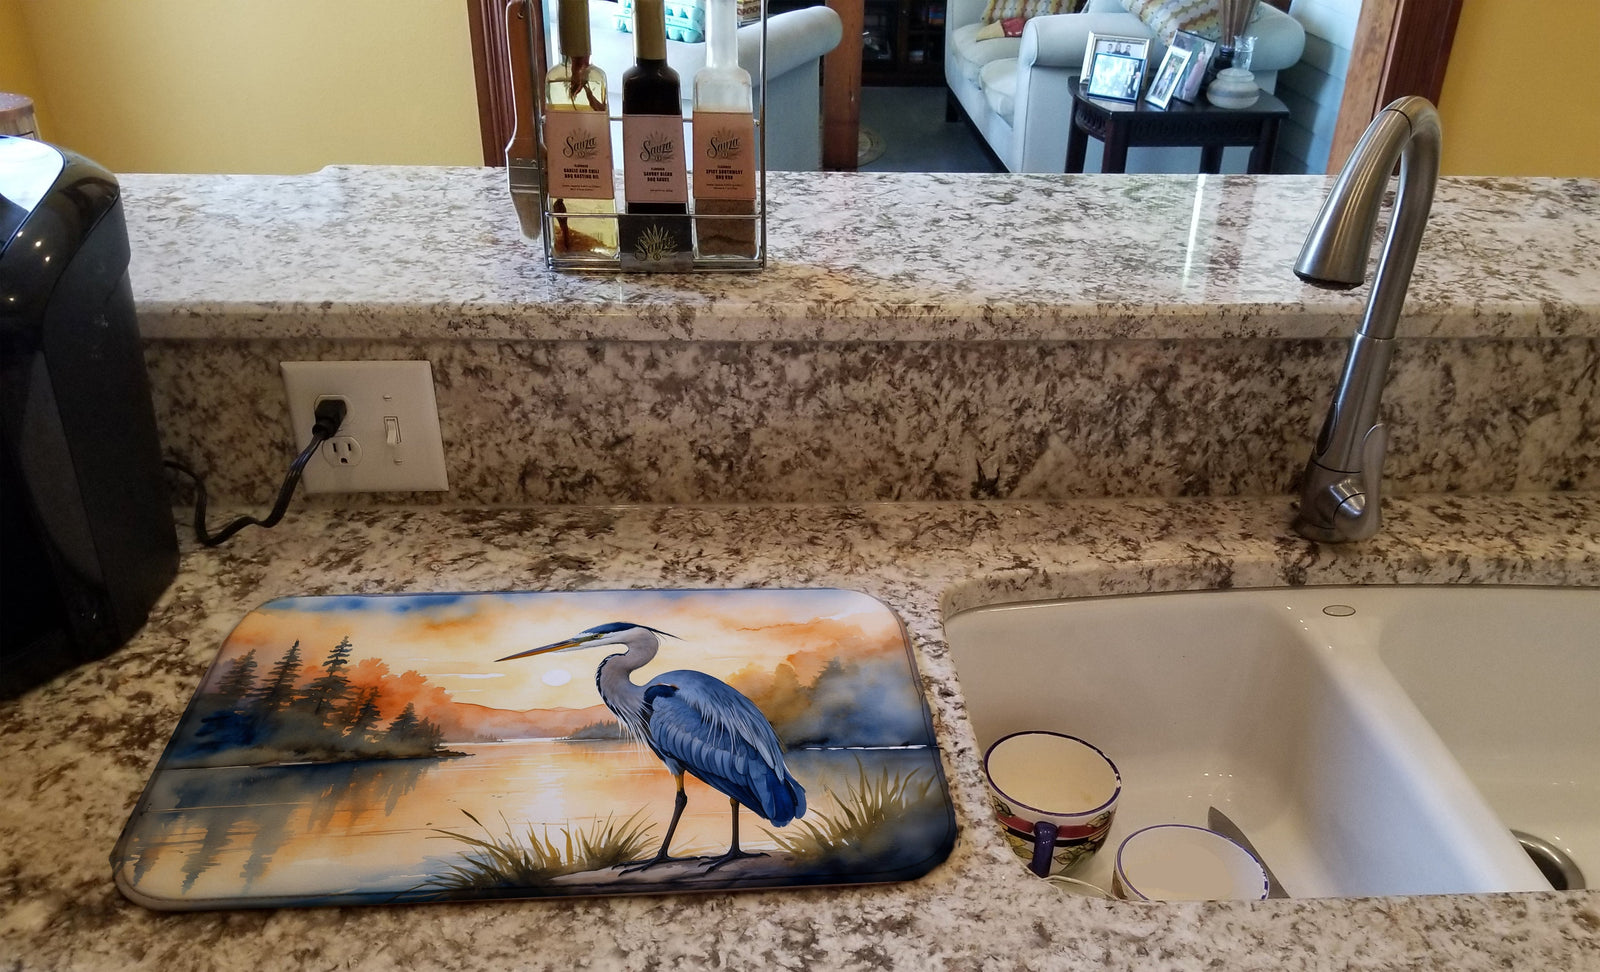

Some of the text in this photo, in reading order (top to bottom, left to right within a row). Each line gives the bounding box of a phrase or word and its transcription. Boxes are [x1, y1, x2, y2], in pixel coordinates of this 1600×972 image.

[563, 136, 597, 158] Sauza
[640, 140, 673, 161] Sauza
[707, 137, 740, 158] Sauza
